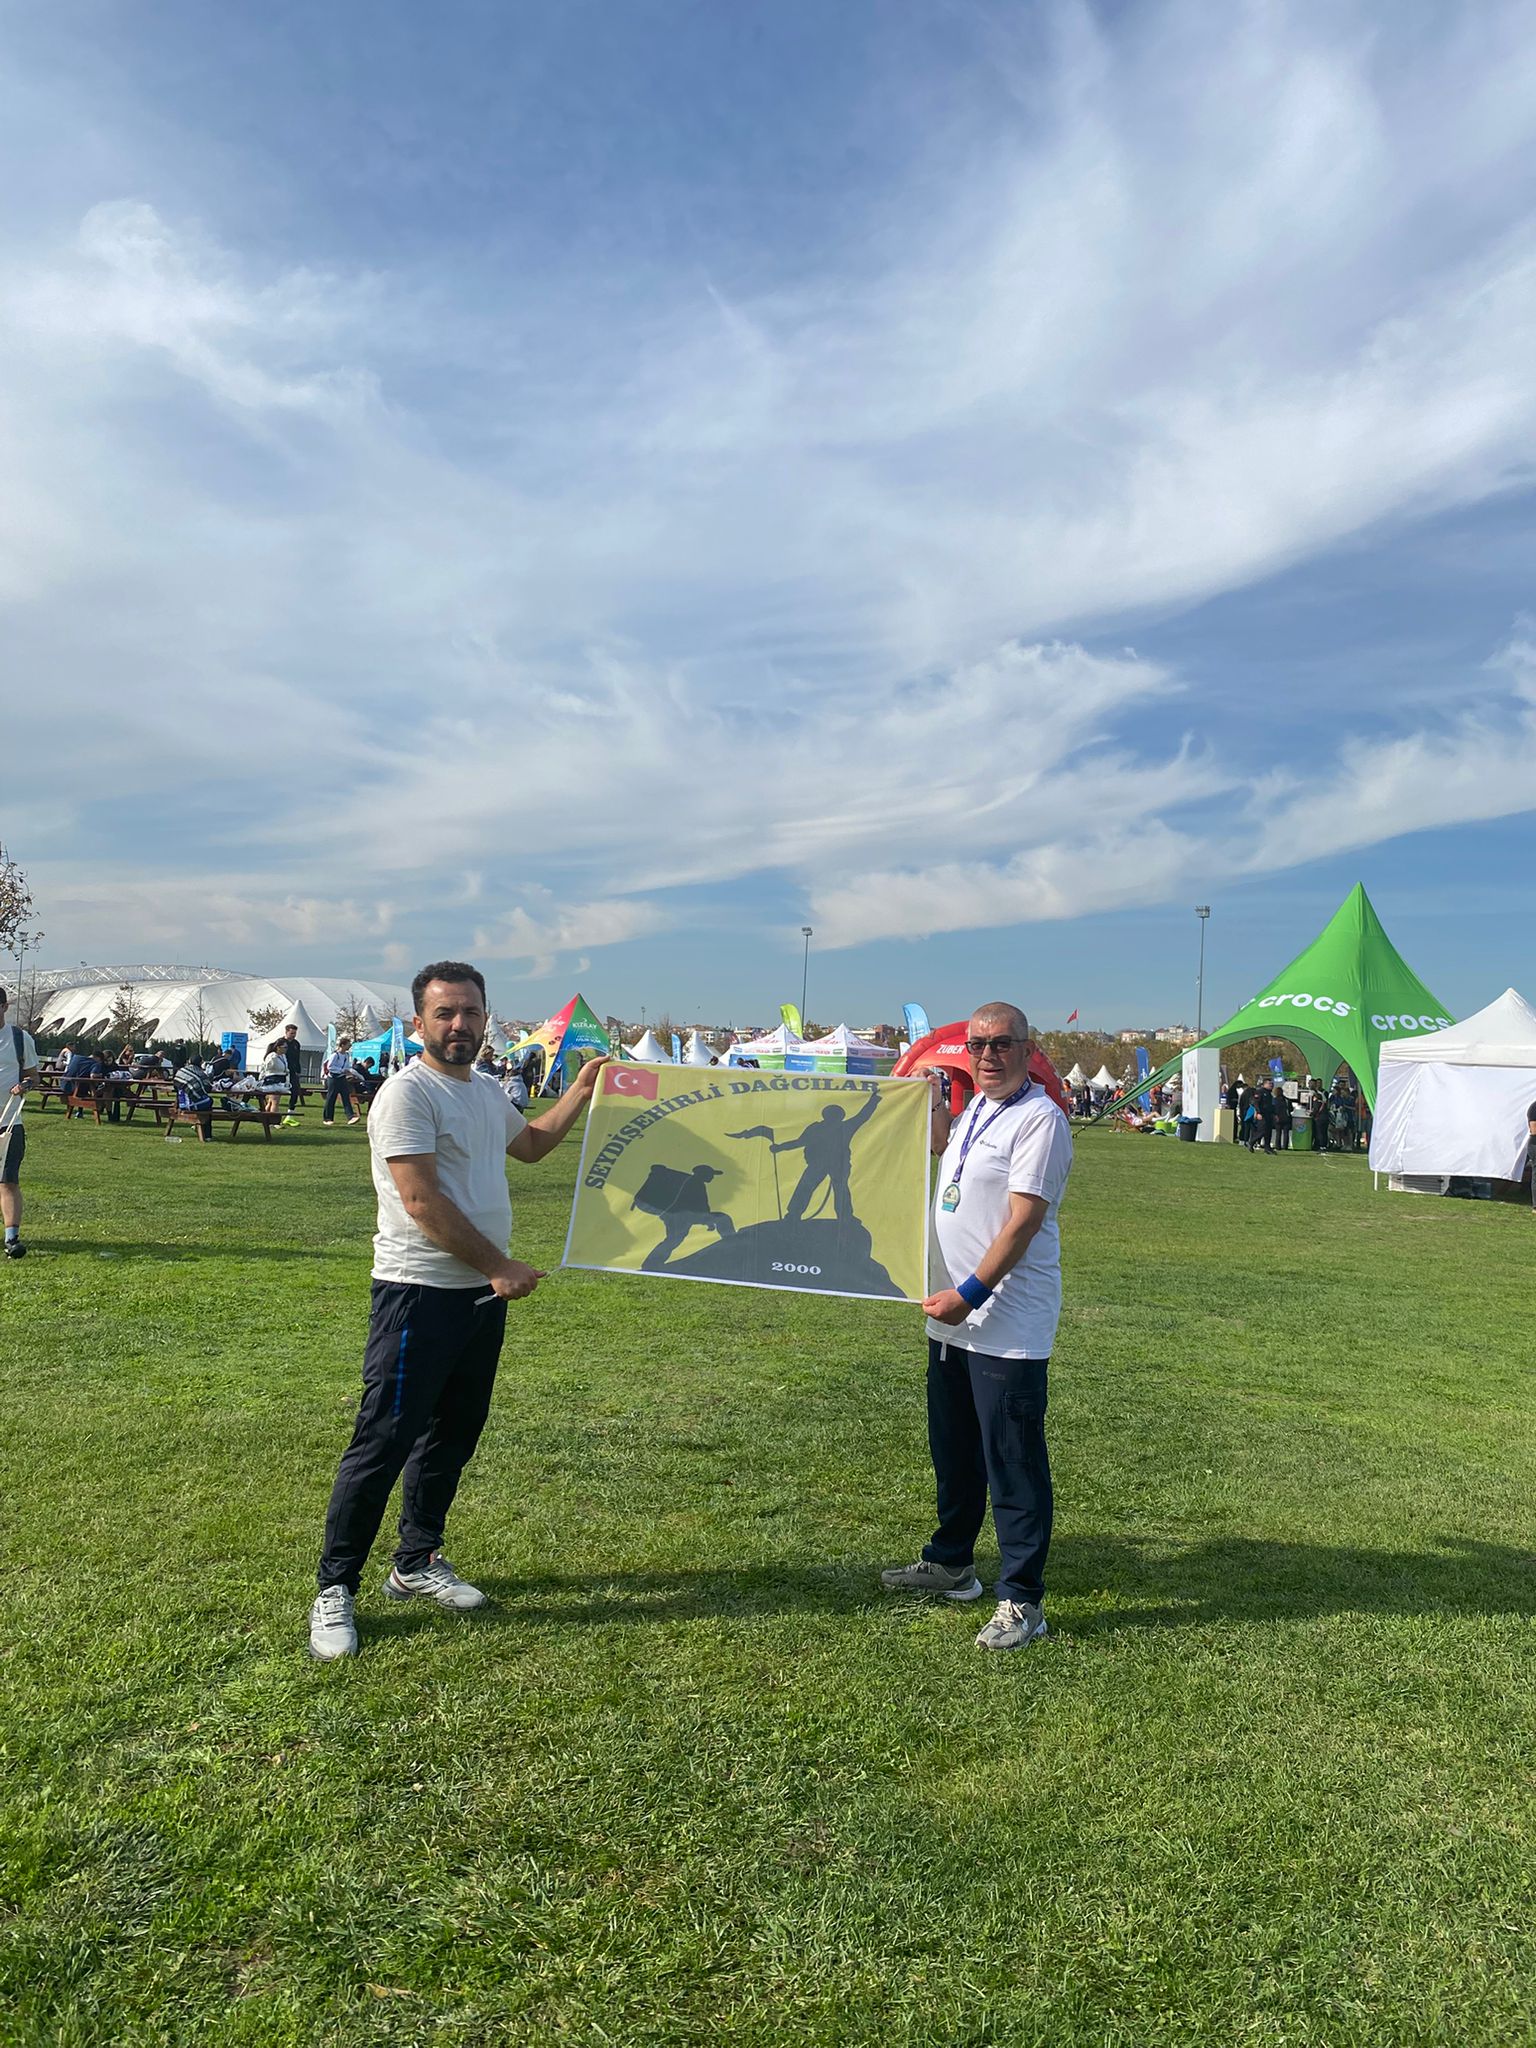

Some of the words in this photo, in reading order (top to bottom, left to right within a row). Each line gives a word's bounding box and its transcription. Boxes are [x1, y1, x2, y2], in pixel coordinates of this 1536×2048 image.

[1258, 993, 1351, 1017] crocs
[1371, 1014, 1450, 1031] crocs
[585, 1083, 724, 1189] SEYDİŞEHİRLİ
[728, 1074, 881, 1095] DAĞCILAR
[771, 1261, 821, 1275] 2000
